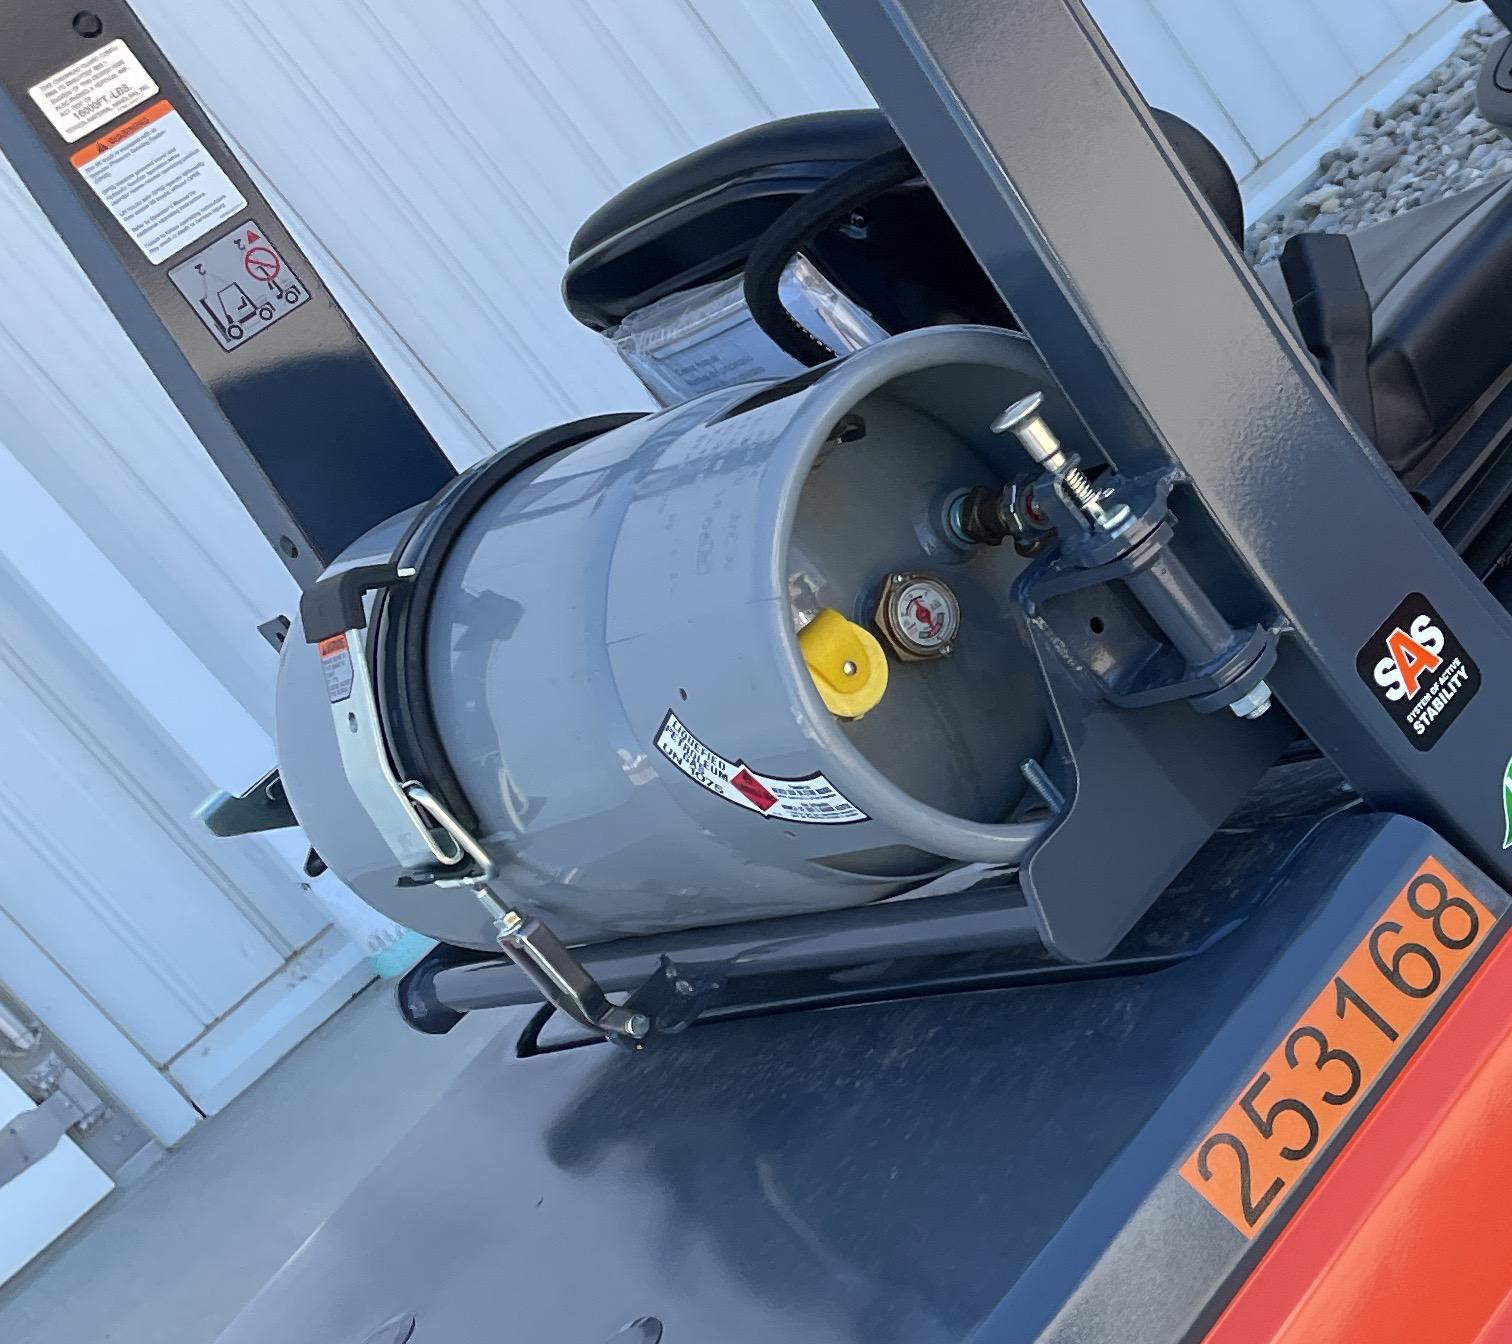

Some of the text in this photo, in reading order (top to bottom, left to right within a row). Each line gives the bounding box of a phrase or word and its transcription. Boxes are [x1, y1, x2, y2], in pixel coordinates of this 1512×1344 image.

[1373, 614, 1445, 701] SAS
[1413, 664, 1469, 735] STABILITY
[662, 742, 684, 766] UN
[690, 767, 724, 794] 1075
[665, 725, 728, 783] PETROLEUM
[672, 720, 726, 771] LIQUEFIED
[1196, 873, 1480, 1228] 253168
